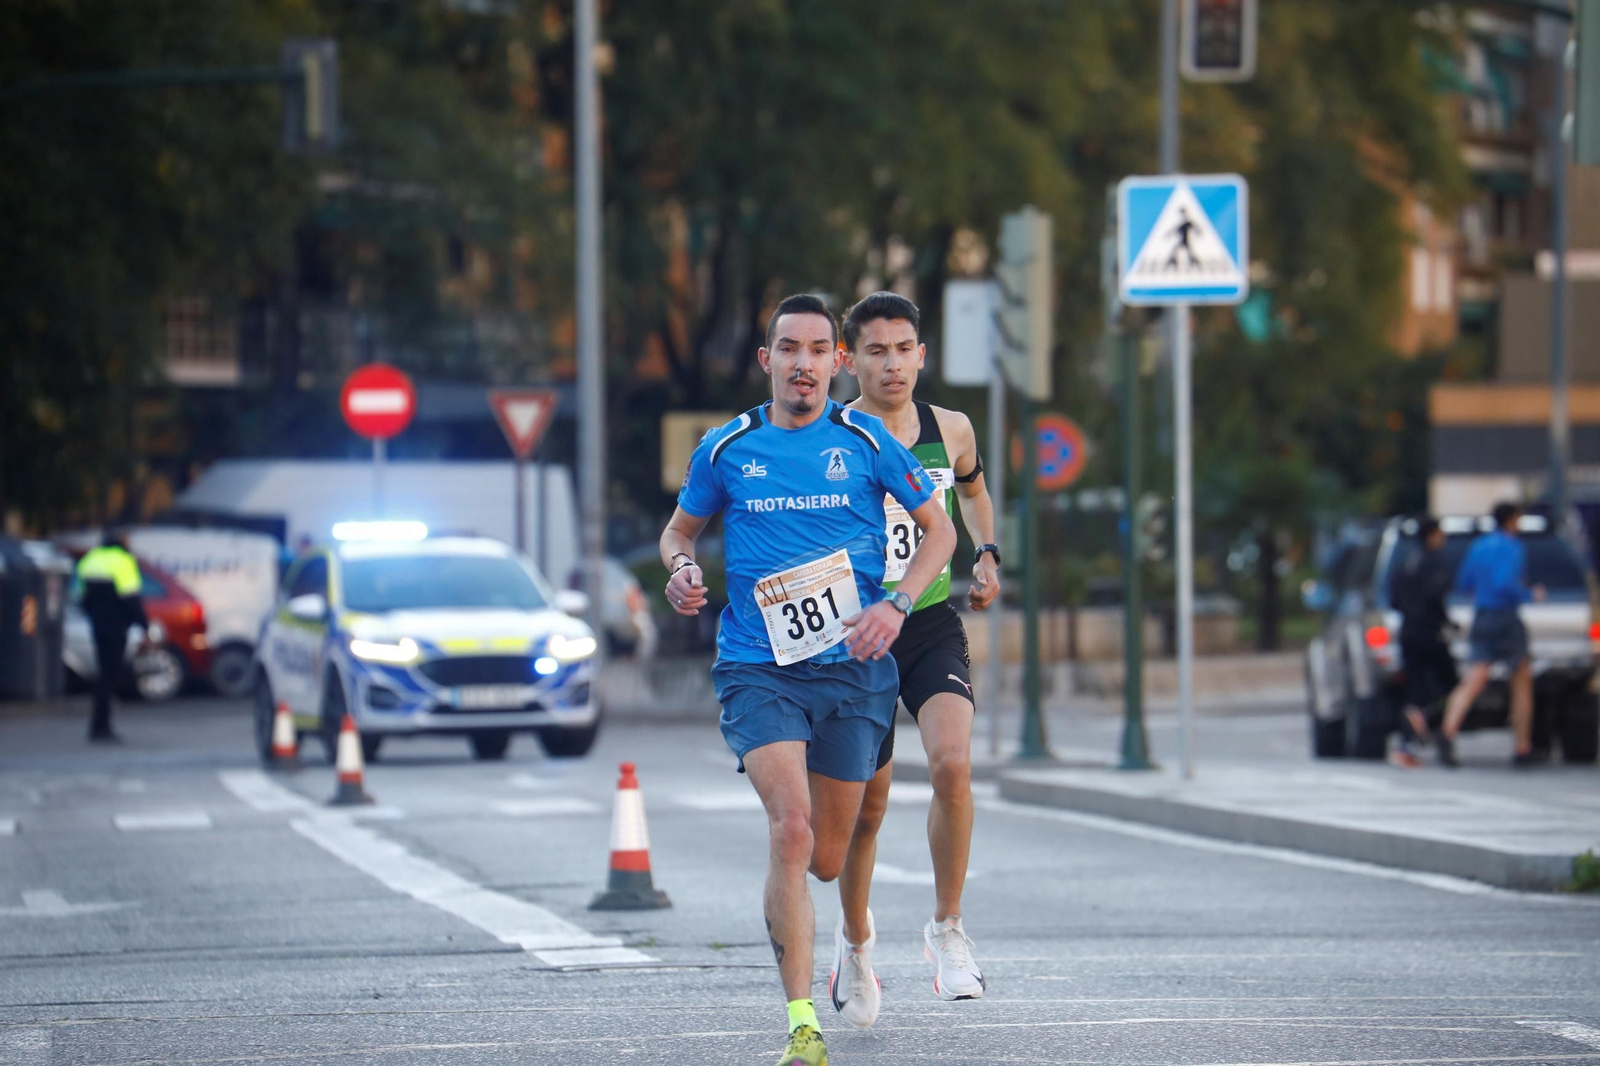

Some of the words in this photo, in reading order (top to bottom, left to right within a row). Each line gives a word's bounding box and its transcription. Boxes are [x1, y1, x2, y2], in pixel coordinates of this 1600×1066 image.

[745, 494, 850, 513] TROTASIERRA
[886, 513, 906, 522] EMORIAL
[883, 524, 923, 561] 36
[792, 566, 814, 578] CARRERA
[812, 559, 833, 573] POPULAR
[757, 577, 789, 607] XLI
[790, 586, 811, 598] MEMORIAL
[782, 587, 840, 640] 381
